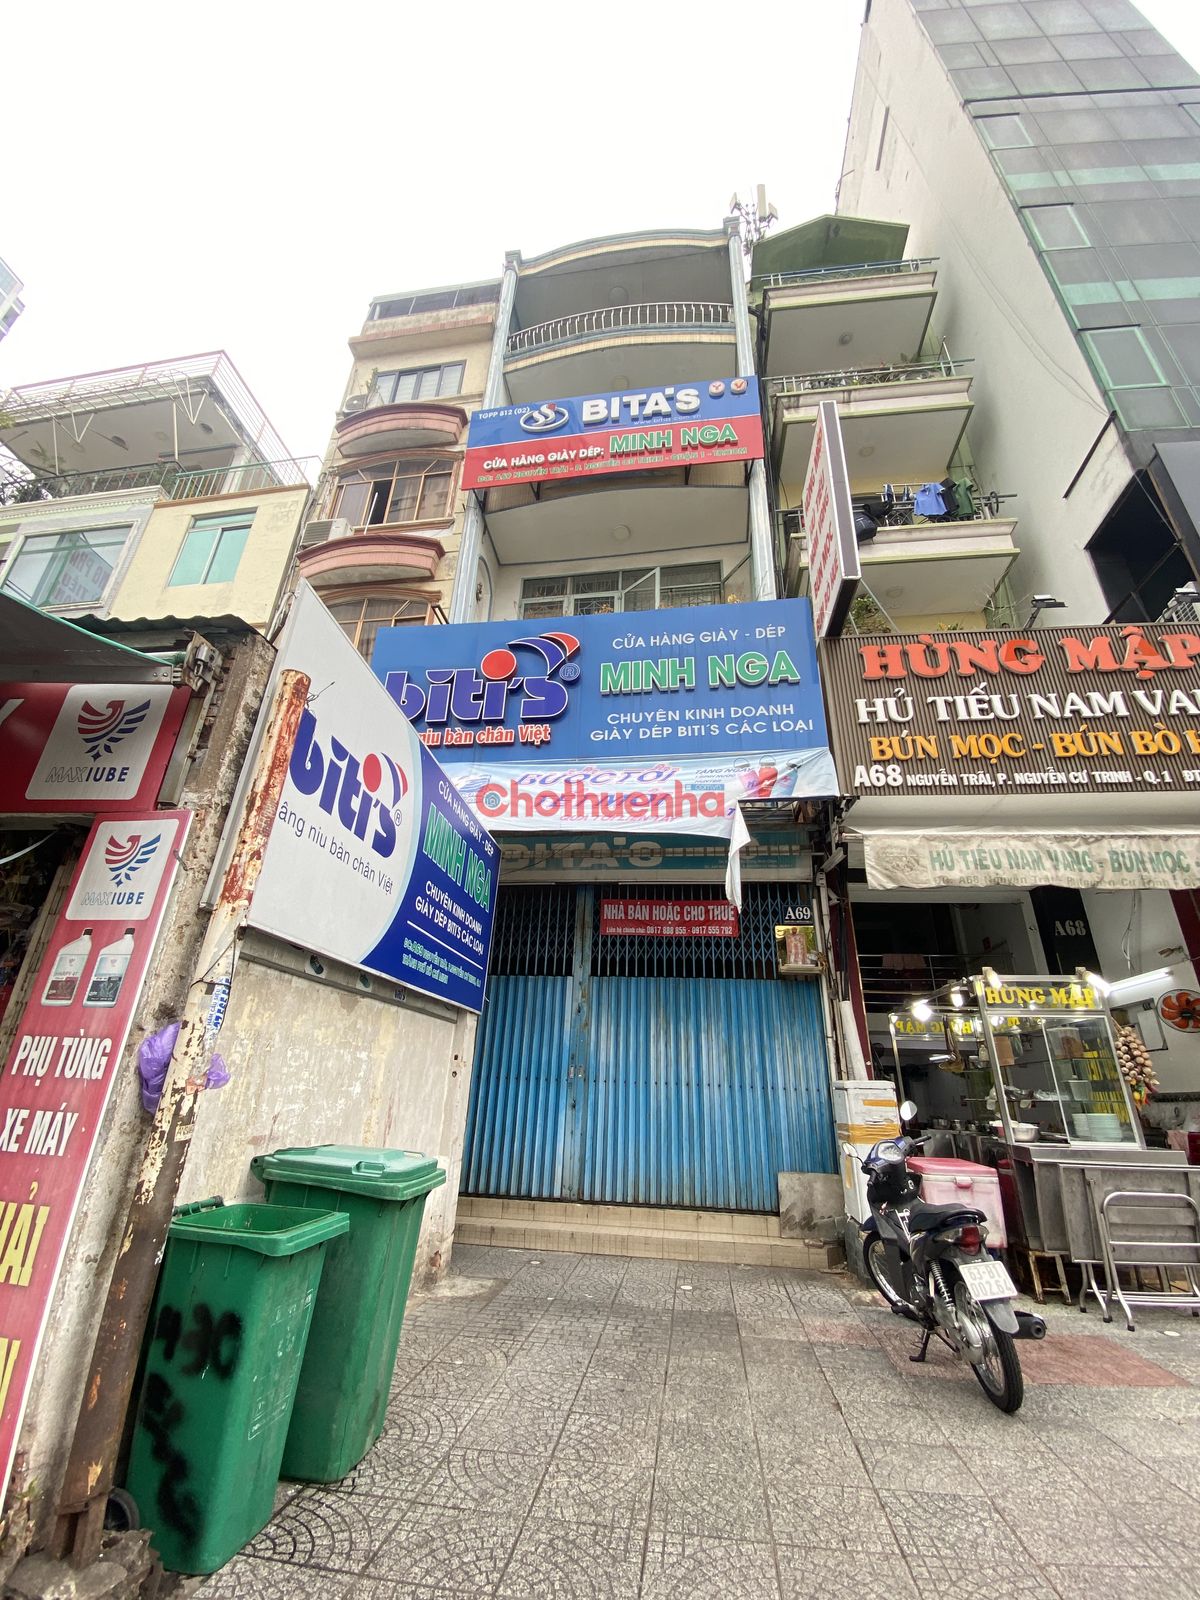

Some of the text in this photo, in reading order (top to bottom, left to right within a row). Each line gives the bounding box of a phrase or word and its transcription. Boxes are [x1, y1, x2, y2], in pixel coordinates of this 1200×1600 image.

[499, 408, 513, 417] 812
[582, 387, 701, 424] BITA'S
[483, 423, 739, 470] CỬA HÀNG GIÀY DÉP: MINH NGA
[612, 632, 646, 649] CỬA
[650, 630, 695, 647] HÀNG
[699, 627, 739, 643] GIÀY
[755, 623, 787, 639] DÉP
[859, 626, 1200, 680] HÙNG MẬP
[600, 650, 801, 695] MINH NGA
[606, 703, 795, 725] CHUYÊN KINH DOANH
[855, 681, 1200, 724] HỦ TIẾU NAM VA
[443, 726, 475, 745] bàn
[476, 725, 515, 744] chân
[518, 723, 551, 746] Việt
[590, 727, 632, 742] GIÀY
[639, 722, 673, 739] DÉP
[725, 719, 767, 735] CÁC
[772, 719, 814, 734] LOẠI
[868, 729, 939, 762] BÚN
[949, 732, 1026, 765] MỌC
[1049, 723, 1125, 758] BÚN
[1128, 722, 1182, 756] BÒ
[854, 763, 904, 787] A68
[905, 768, 959, 787] NGUYỄN
[959, 770, 996, 787] TRÃI,
[1014, 766, 1068, 785] NGUYỄN
[1068, 769, 1089, 784] CƯ
[1091, 770, 1133, 784] TRINH
[438, 781, 453, 807] CỬA
[452, 798, 470, 828] HÀNG
[469, 819, 483, 843] GIÀY
[484, 839, 495, 857] DÉP
[308, 824, 328, 849] niu
[329, 836, 351, 866] bàn
[352, 856, 376, 883] chân
[378, 870, 394, 896] Việt
[423, 802, 468, 887] MINH
[464, 847, 492, 914] NGA
[1004, 849, 1046, 871] NAM
[959, 875, 980, 885] A68
[415, 896, 435, 920] GIÀY
[434, 909, 448, 929] DÉP
[461, 930, 474, 947] CÁC
[425, 880, 483, 936] CHUYÊN KINH DOANH
[604, 901, 626, 920] NHÀ
[627, 901, 650, 921] BÁN
[652, 902, 681, 925] HOẶC
[683, 905, 705, 921] CHO
[785, 906, 811, 920] A69
[1054, 920, 1087, 937] A68
[985, 983, 1047, 1005] HÙNG
[11, 1028, 113, 1087] PHỤ TÙNG
[0, 1102, 79, 1157] XE MÁY
